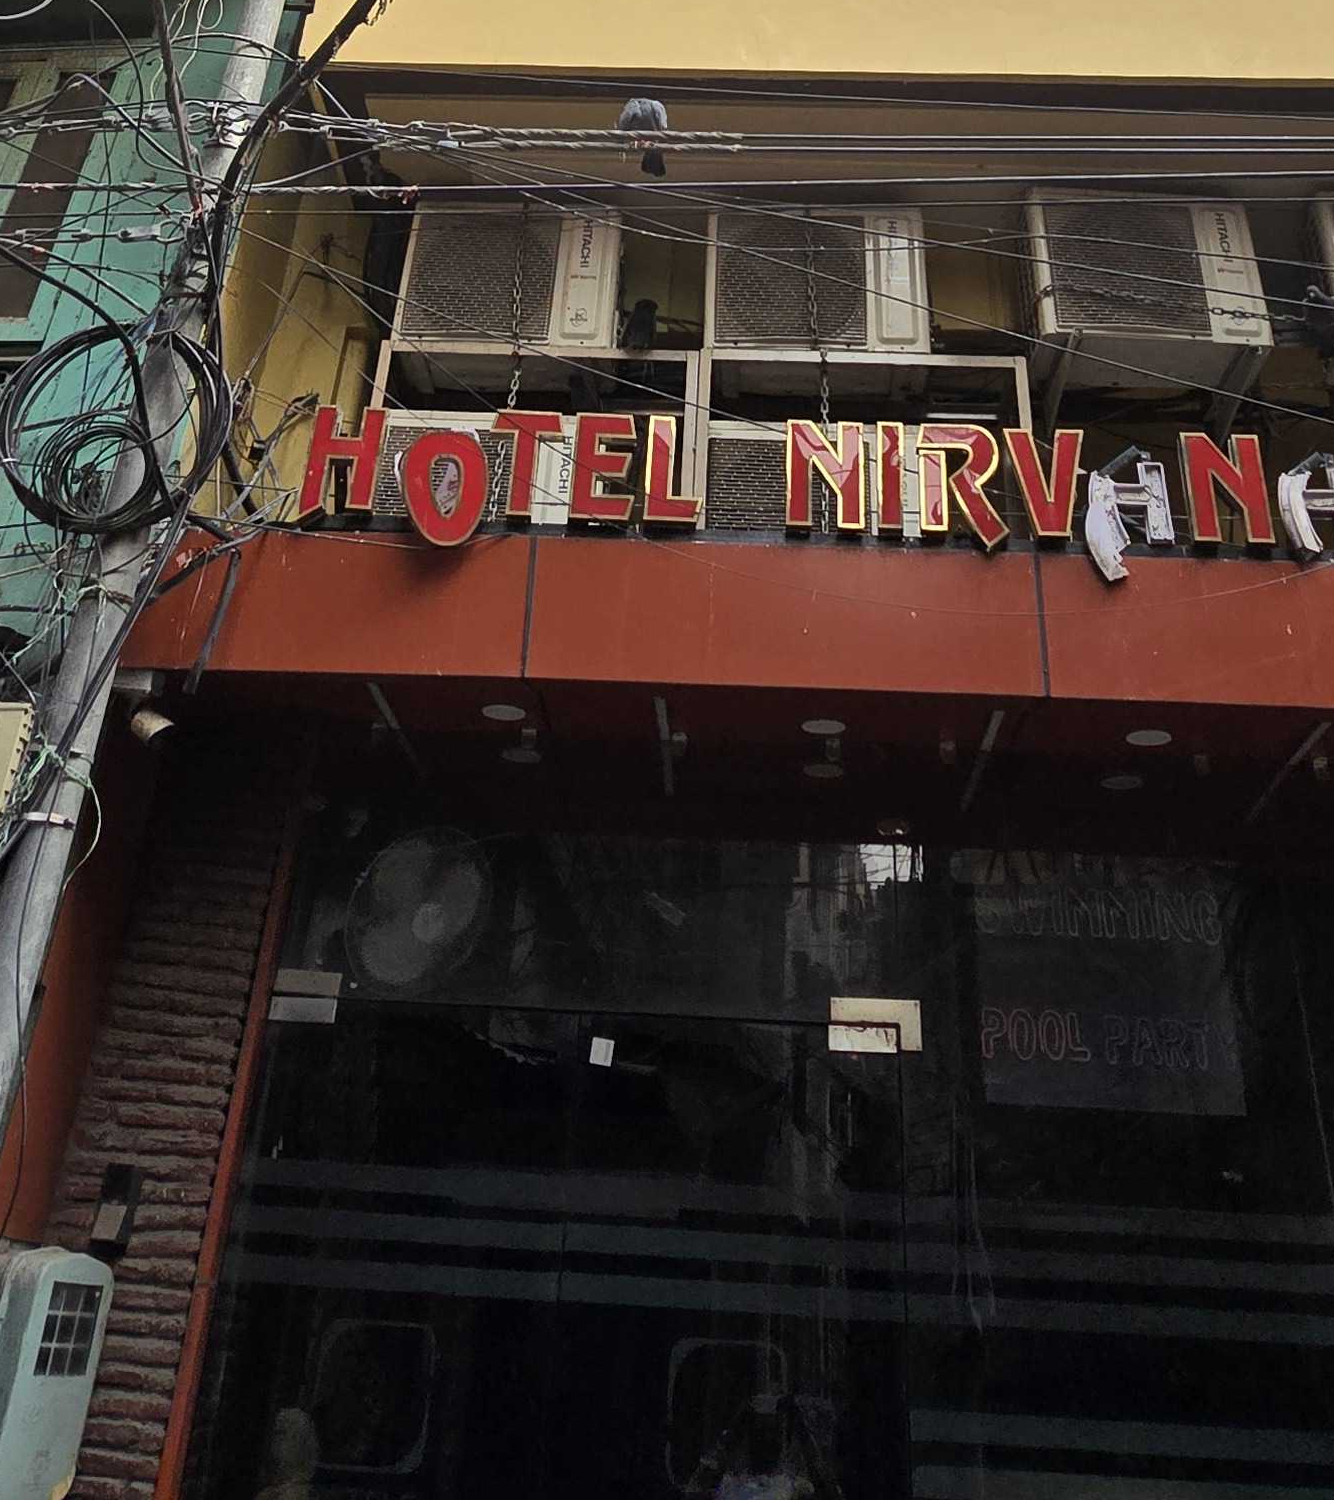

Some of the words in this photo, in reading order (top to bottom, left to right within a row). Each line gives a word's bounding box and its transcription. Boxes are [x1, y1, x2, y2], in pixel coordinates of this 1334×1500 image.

[579, 218, 594, 269] HITACHI
[297, 404, 703, 547] HOTEL
[980, 1006, 1092, 1063] POOL
